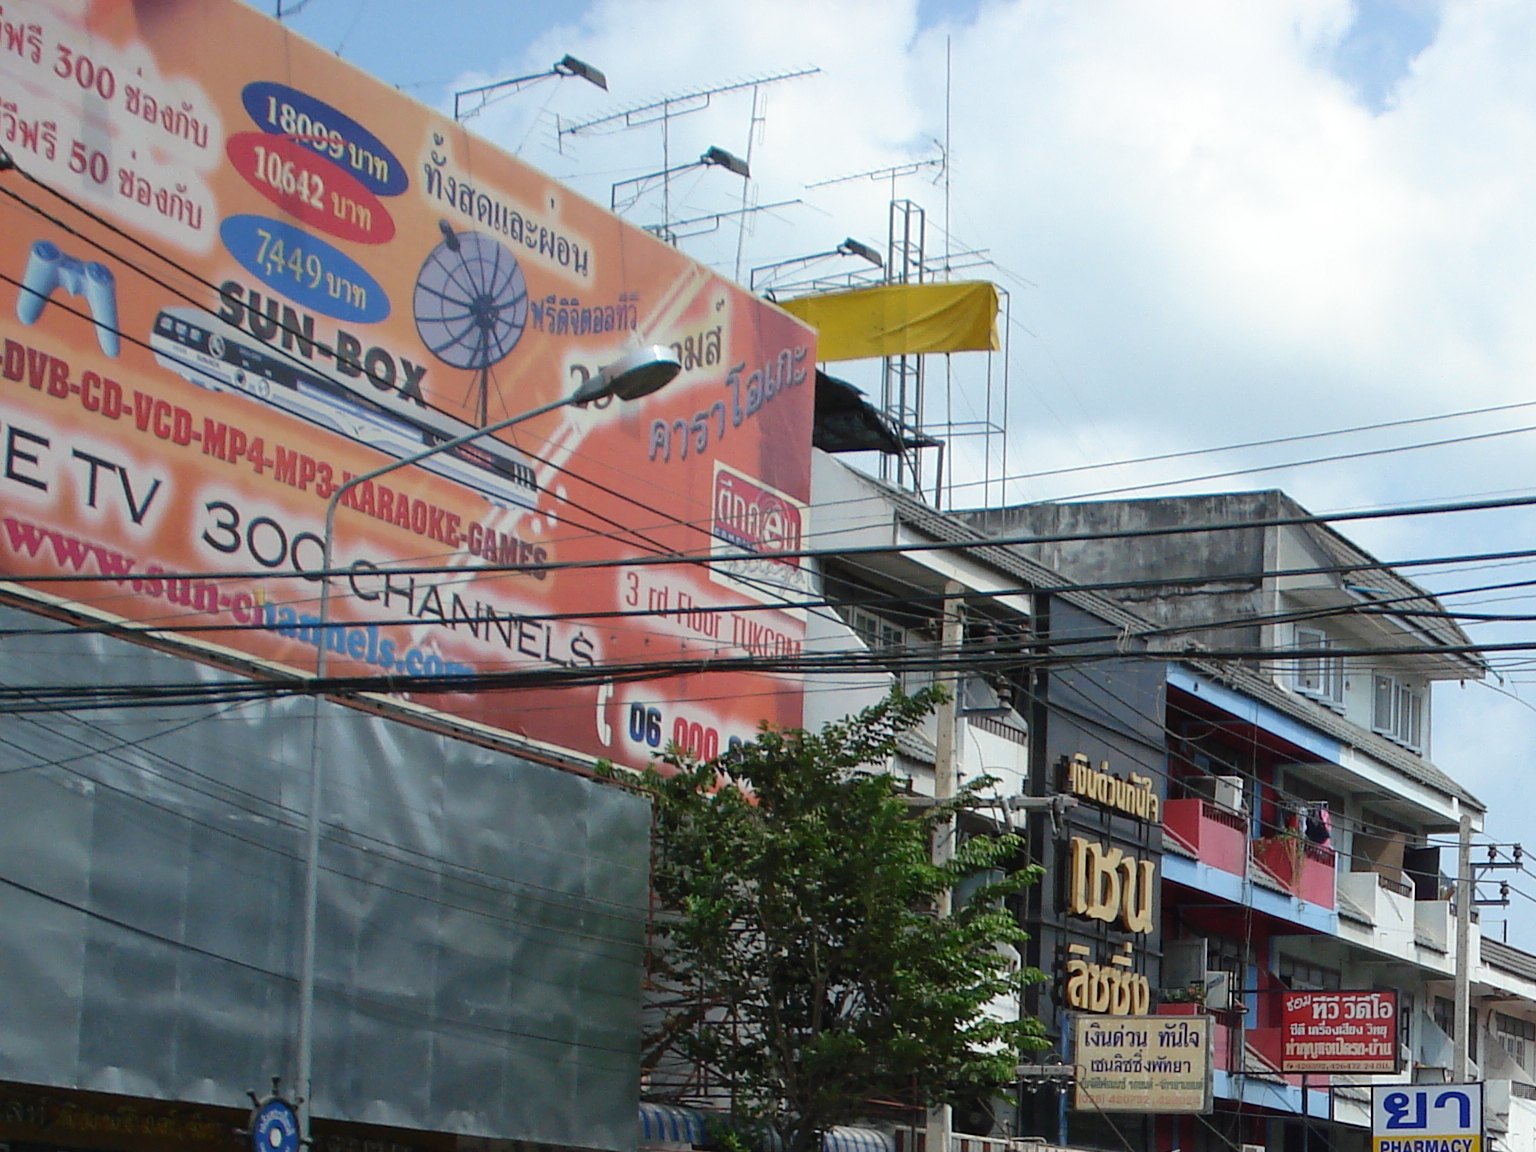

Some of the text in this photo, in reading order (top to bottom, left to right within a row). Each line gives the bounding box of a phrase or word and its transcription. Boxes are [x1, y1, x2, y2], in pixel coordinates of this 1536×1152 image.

[53, 42, 115, 100] 300
[124, 66, 208, 149] ช่องกับ
[68, 138, 109, 185] 50
[118, 149, 202, 230] ช่องกับ
[347, 142, 389, 184] บาท
[424, 132, 588, 278] ทั้งสดและผ่อน
[330, 191, 373, 232] บาท
[256, 228, 368, 311] 7,449 บาท
[219, 279, 429, 408] SUN-BOX
[649, 345, 808, 463] คาราโอเกะ
[3, 518, 476, 682] www.sun-channels.com
[202, 500, 330, 582] 300
[348, 559, 594, 669] CHANNELS
[626, 572, 801, 659] 3 rd Floor TUKCOM
[629, 702, 661, 747] 06
[1084, 1022, 1199, 1047] เงินด่วน ทันใจ
[1286, 994, 1394, 1019] ซ่อม ทีวี วีดีโอ
[1308, 1020, 1363, 1036] เครื่องเสียง
[1366, 1023, 1388, 1038] วิทยุ
[1383, 1091, 1470, 1129] ยา
